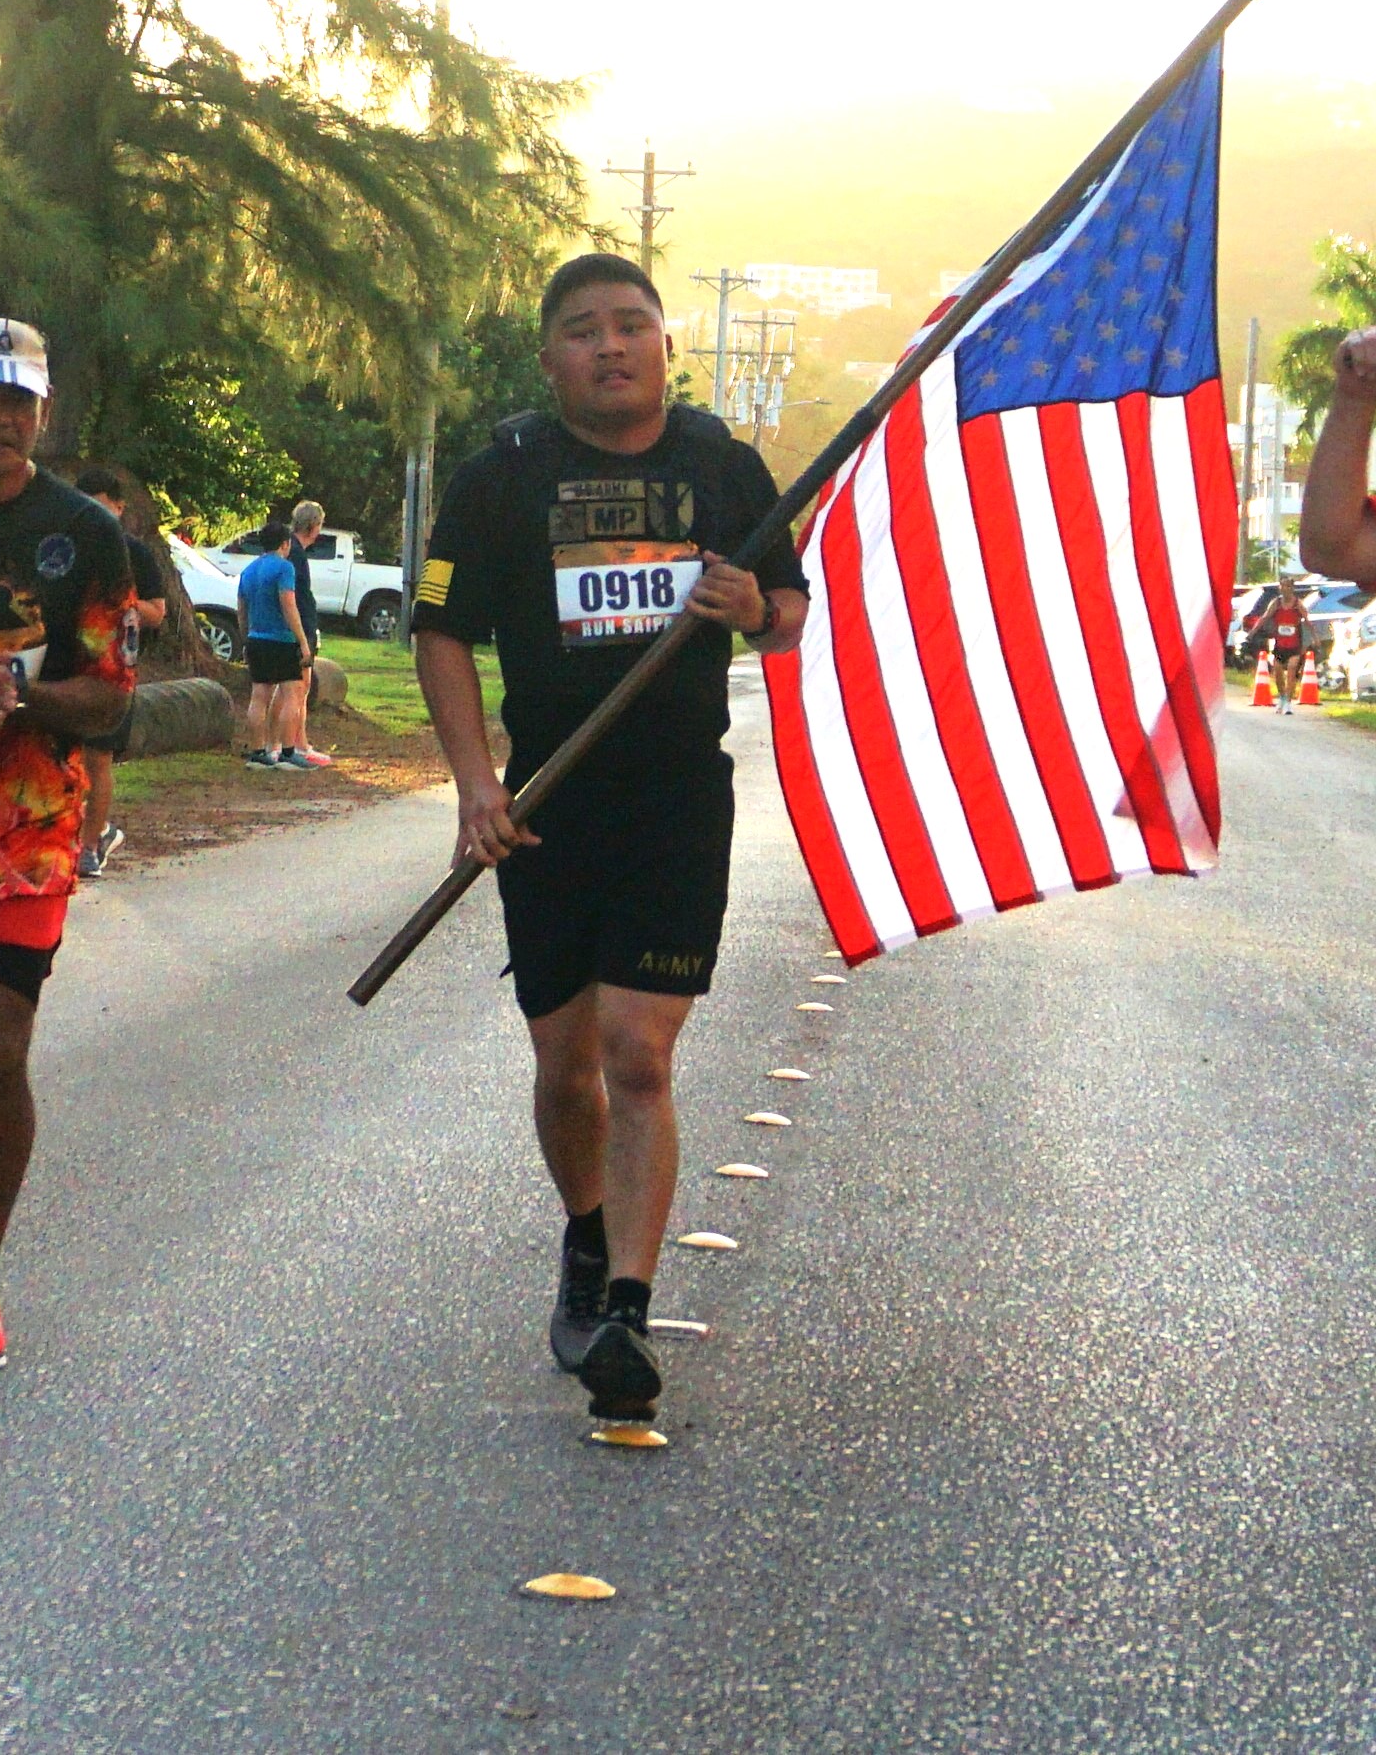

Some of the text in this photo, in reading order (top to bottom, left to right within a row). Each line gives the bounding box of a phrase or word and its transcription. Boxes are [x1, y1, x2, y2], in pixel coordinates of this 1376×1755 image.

[595, 507, 638, 531] MP
[578, 566, 675, 612] 0918
[581, 620, 616, 637] RUN
[637, 950, 704, 977] ARMY
